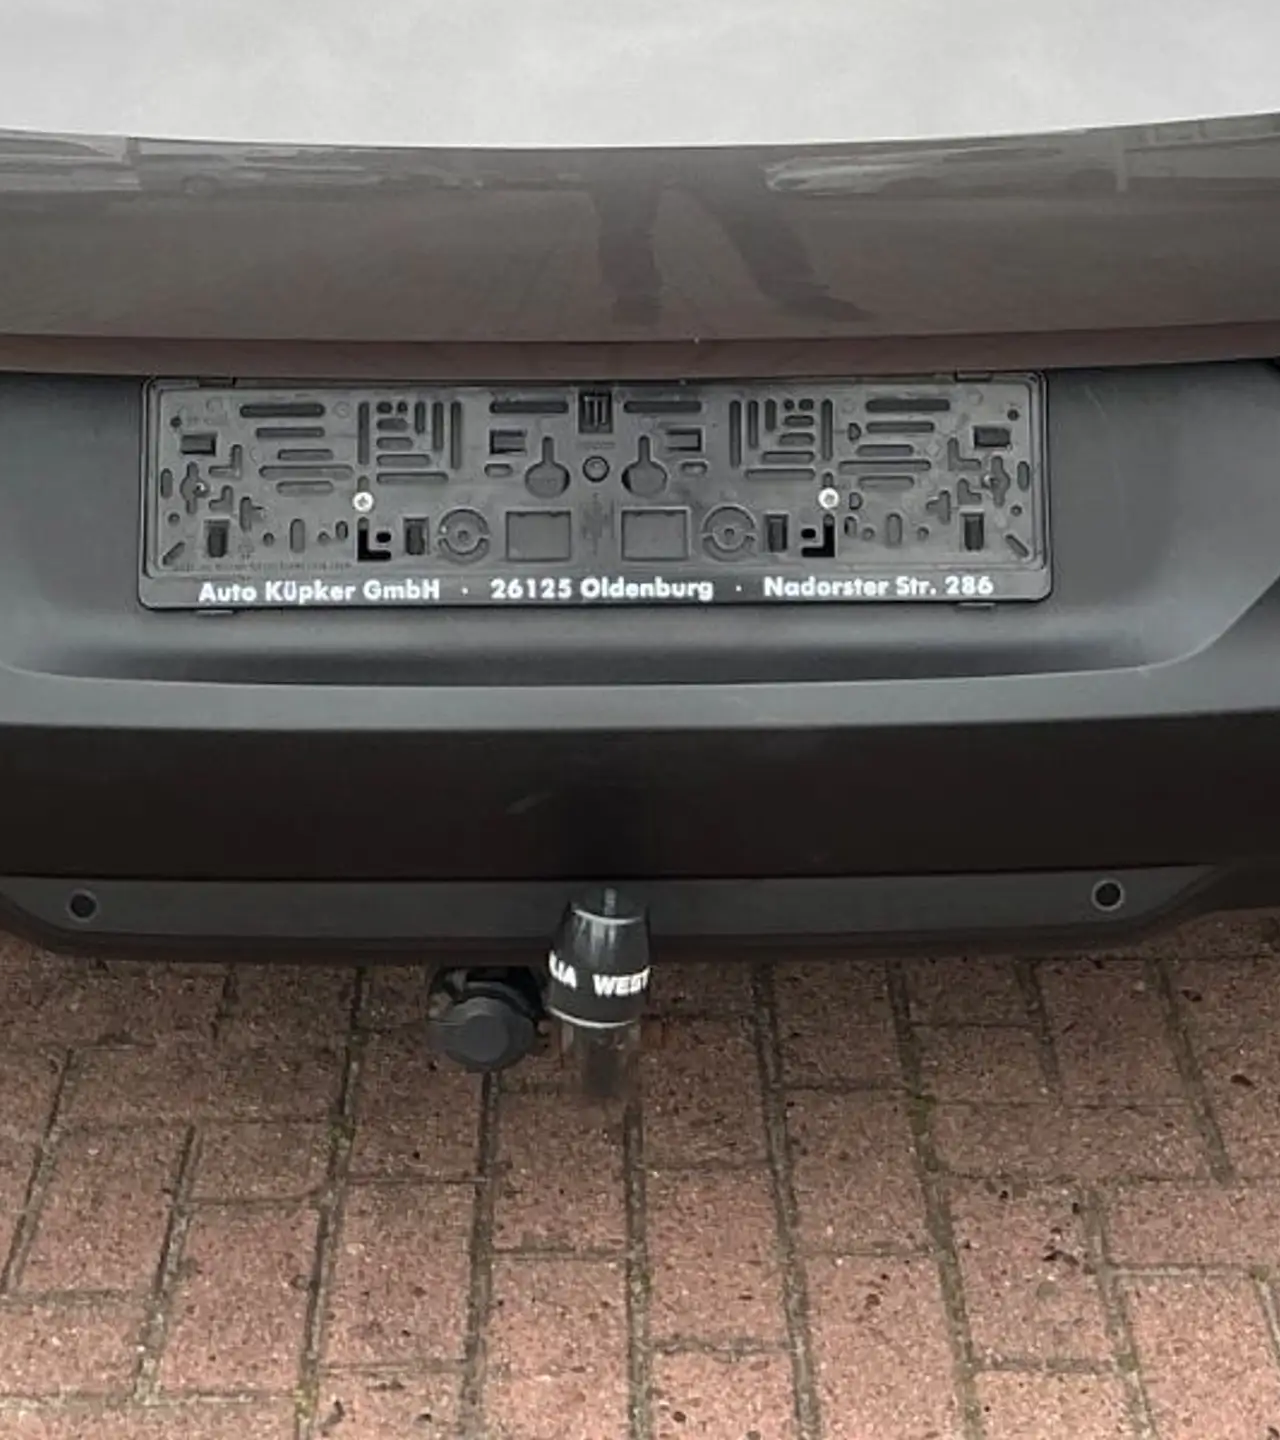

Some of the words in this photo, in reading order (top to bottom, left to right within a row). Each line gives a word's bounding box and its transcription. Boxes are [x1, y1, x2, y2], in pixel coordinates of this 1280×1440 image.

[198, 580, 258, 603] Auto
[265, 578, 356, 605] Küpker
[362, 579, 441, 601] GmbH
[489, 578, 573, 600] 26125
[580, 576, 714, 602] Oldenburg
[763, 575, 890, 598] Nadorster
[895, 575, 937, 597] Str.
[944, 574, 995, 596] 286
[591, 965, 651, 998] WEST
